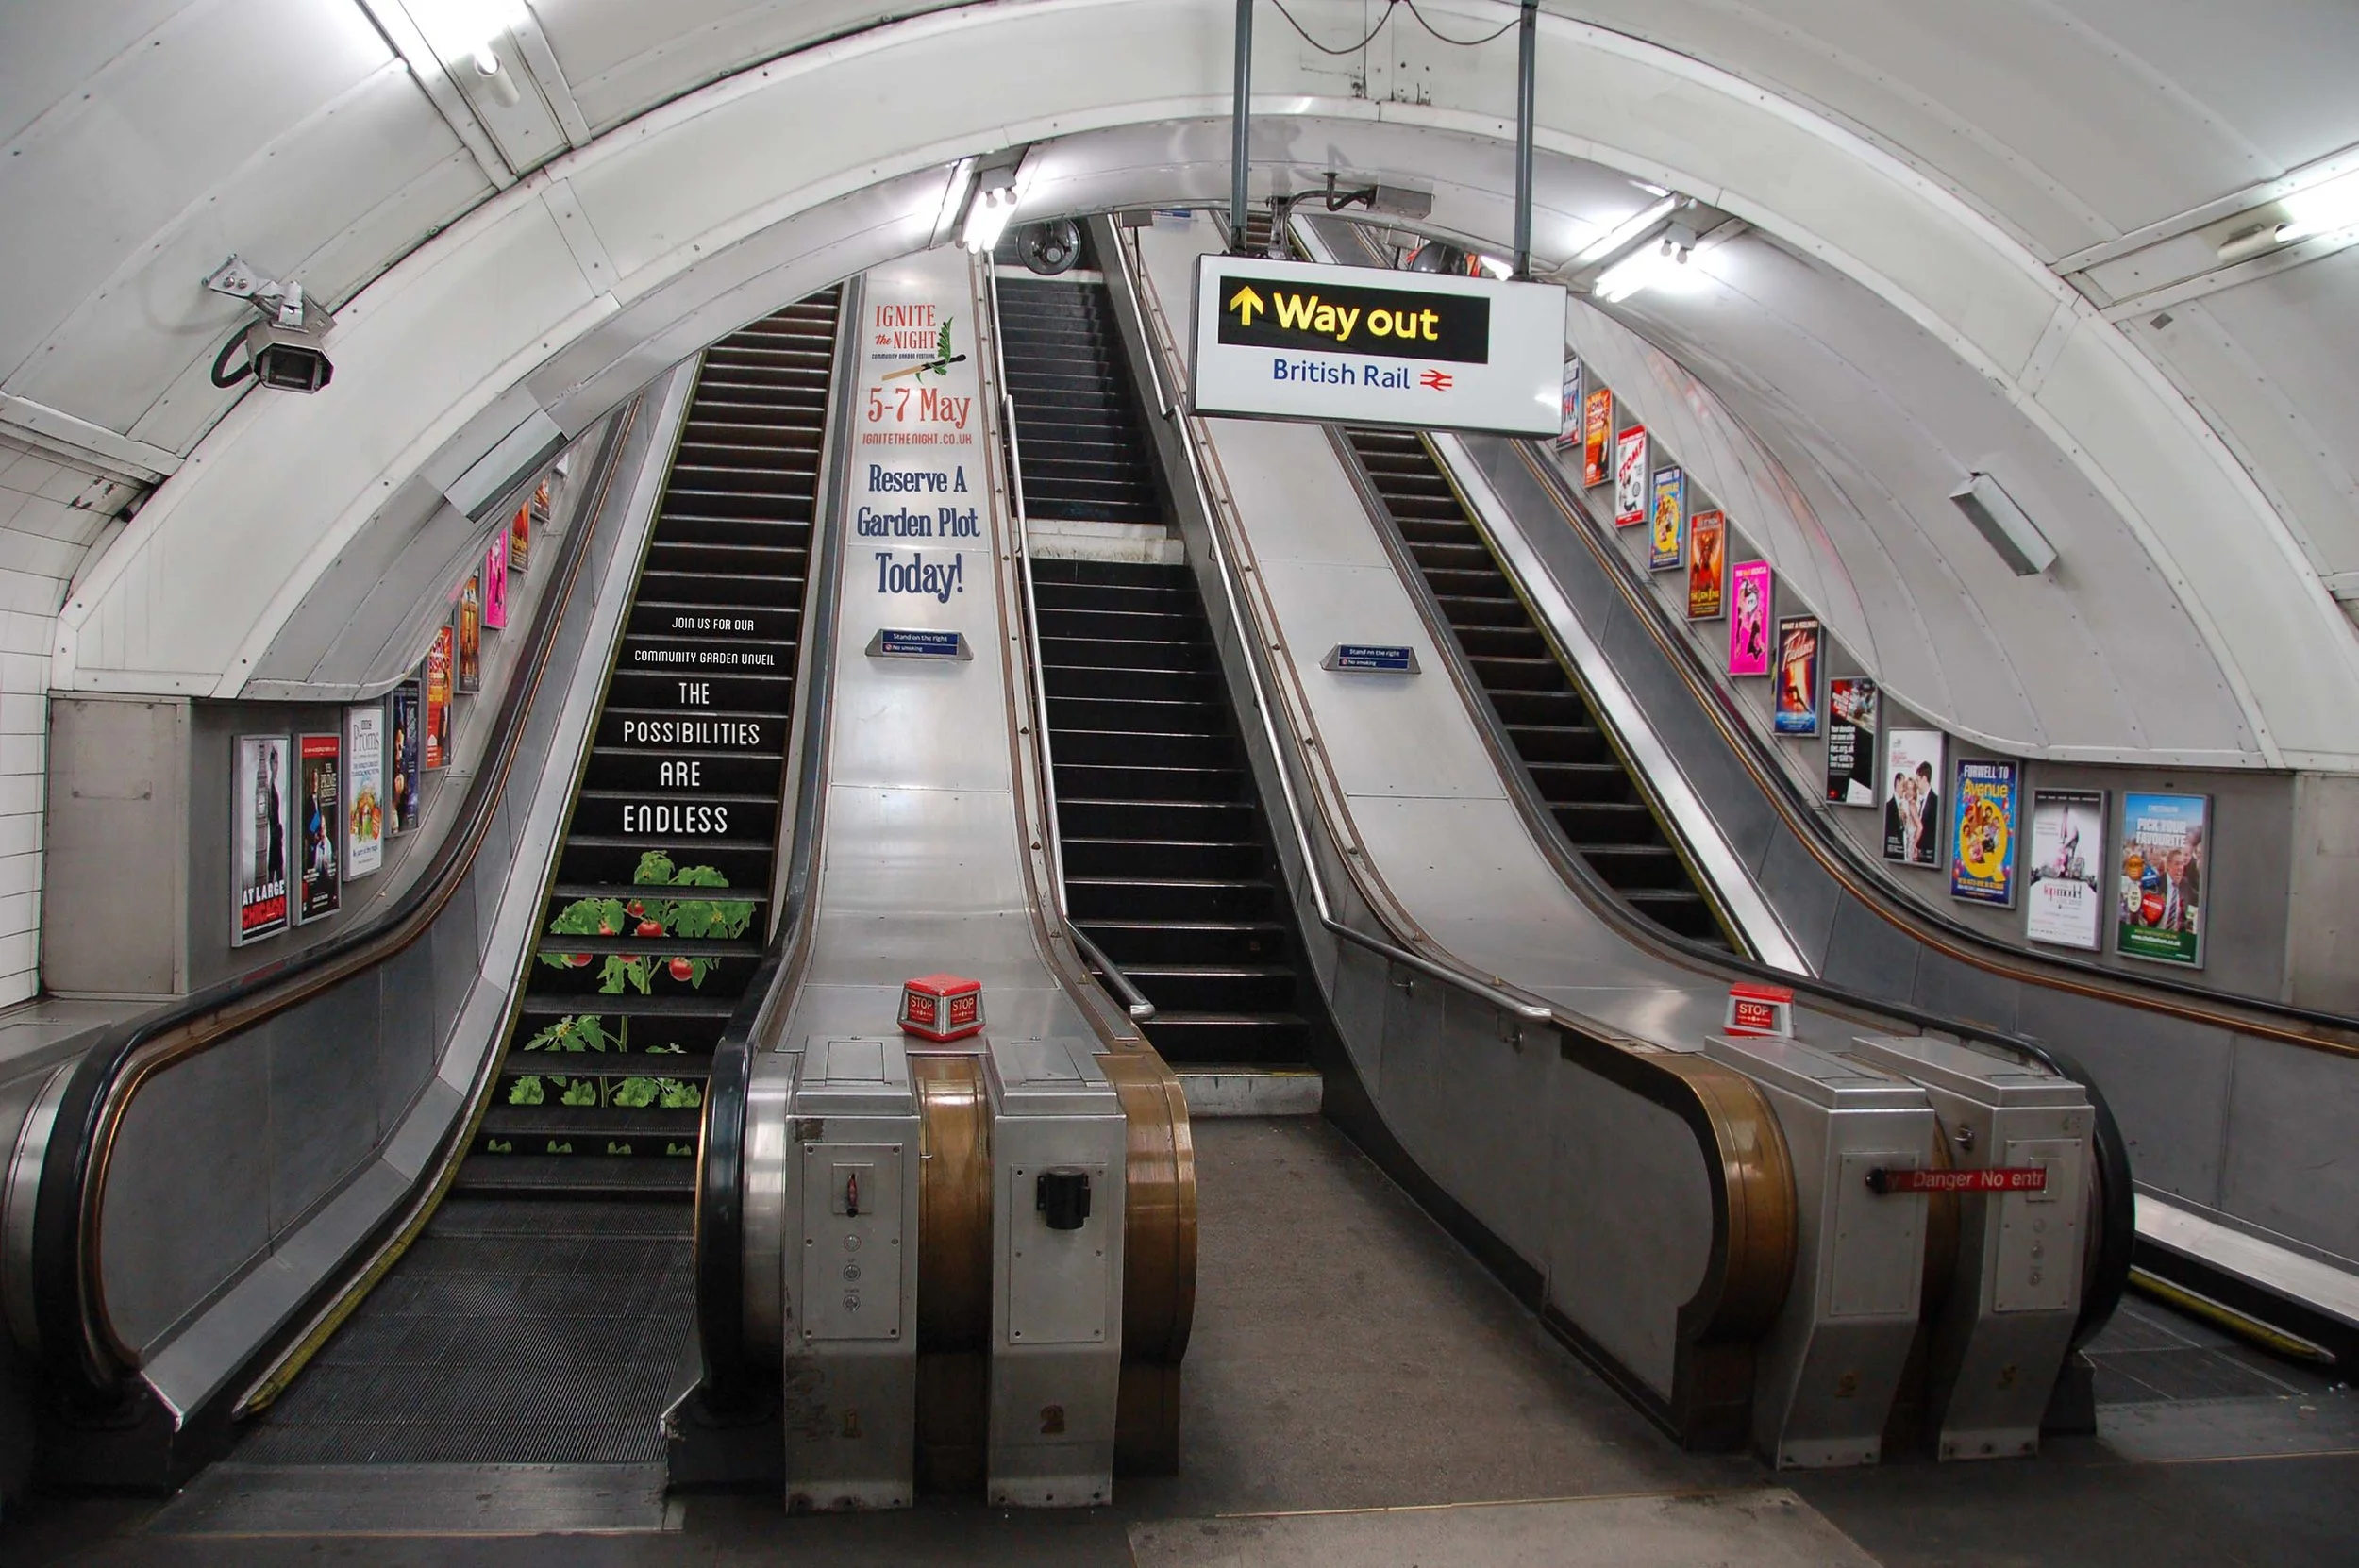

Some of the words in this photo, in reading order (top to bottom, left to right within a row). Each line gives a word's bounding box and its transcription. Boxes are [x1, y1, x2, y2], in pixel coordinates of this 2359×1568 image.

[876, 305, 936, 327] IGNITE
[1273, 292, 1361, 342] Way
[1367, 308, 1439, 341] out
[876, 333, 892, 345] the
[894, 330, 937, 349] NIGHT
[1274, 359, 1355, 386] British
[1364, 363, 1410, 389] Rail
[868, 388, 910, 422] 5-7
[920, 388, 971, 429] May
[862, 433, 972, 446] IGNITETHENIGHT.CO.UK
[868, 464, 947, 492] Reserve
[953, 465, 968, 492] A
[857, 507, 932, 537] Garden
[938, 508, 980, 537] Plot
[875, 553, 963, 604] Today!
[672, 617, 694, 628] JOIN
[697, 618, 711, 629] US
[713, 619, 731, 630] FOR
[734, 619, 754, 631] OUR
[932, 634, 947, 642] right
[634, 649, 696, 663] COMMUNITY
[699, 652, 738, 664] GARDEN
[741, 653, 775, 666] UNVEIL
[1386, 649, 1400, 658] right
[678, 683, 710, 705] THE
[624, 721, 761, 744] POSSIBILITIES
[661, 761, 701, 787] ARE
[1999, 766, 2010, 779] TO
[1964, 778, 2009, 798] Avenue
[624, 805, 728, 834] ENDLESS
[243, 888, 255, 906] AT
[256, 880, 285, 902] LARGE
[911, 995, 932, 1009] STOP
[952, 997, 974, 1011] STOP
[1739, 1003, 1769, 1016] STOP
[1914, 1171, 1972, 1190] Danger
[1982, 1171, 2004, 1186] No
[1040, 1404, 1065, 1434] 2
